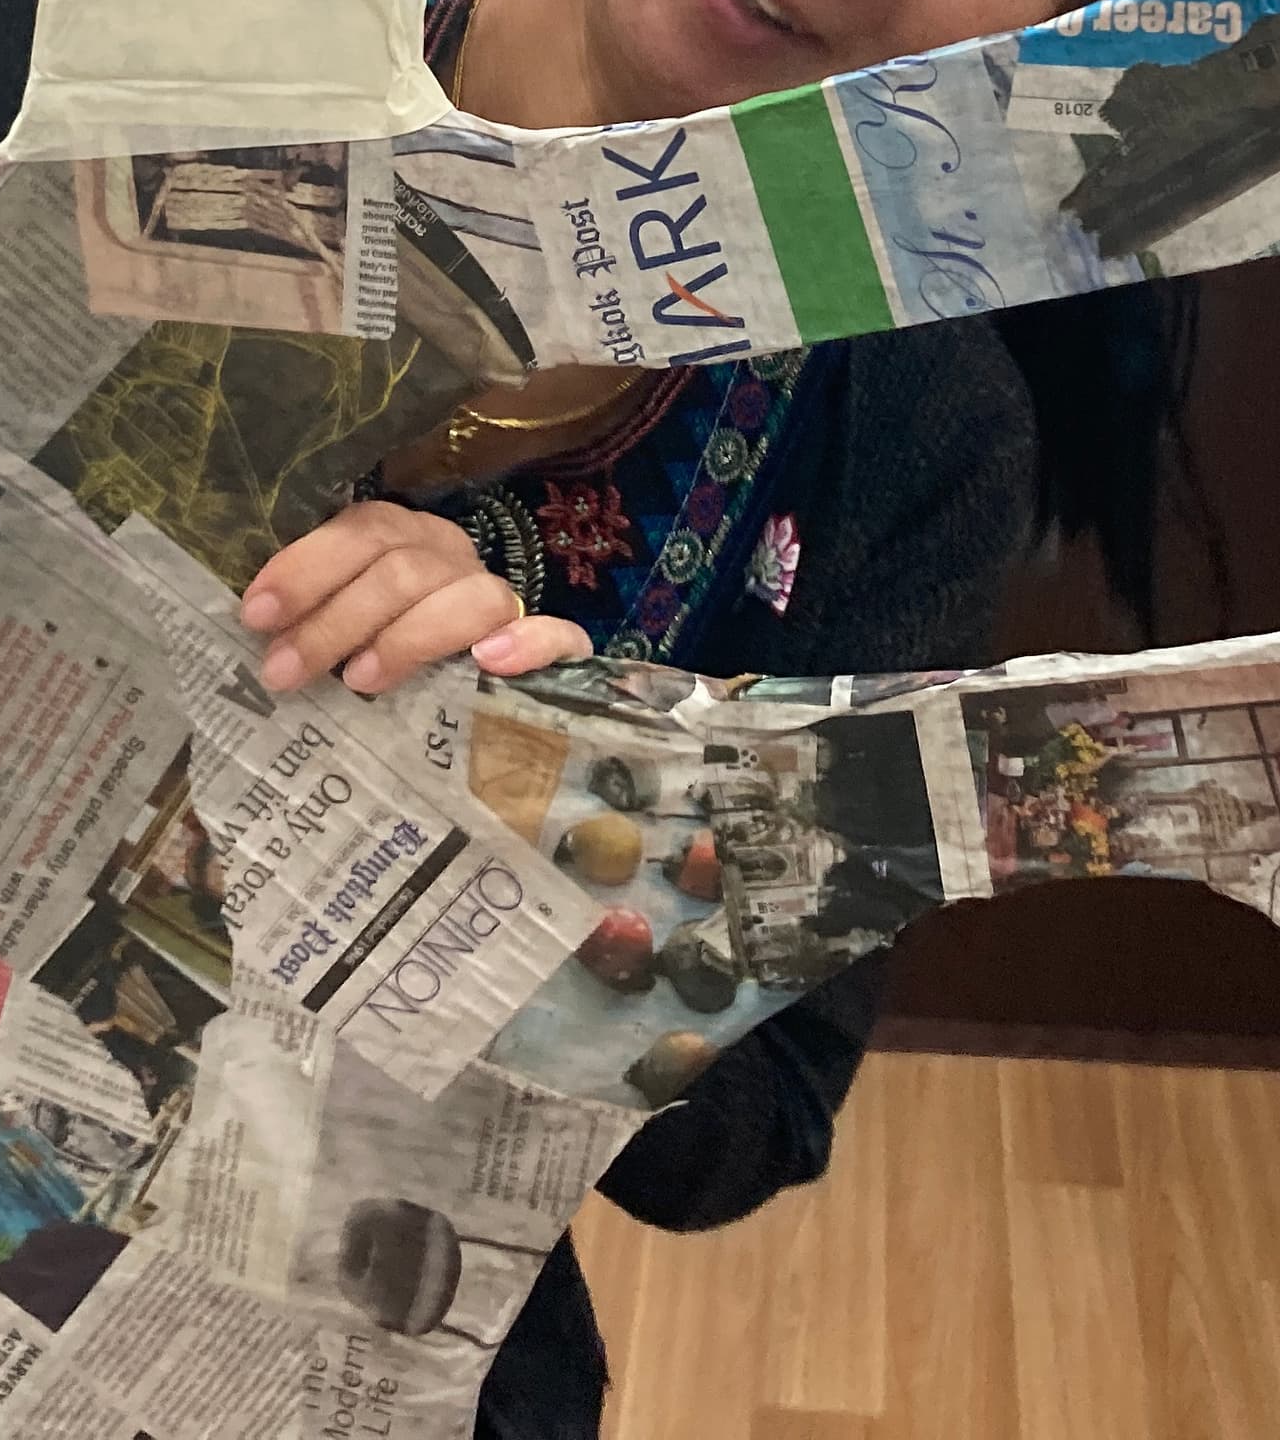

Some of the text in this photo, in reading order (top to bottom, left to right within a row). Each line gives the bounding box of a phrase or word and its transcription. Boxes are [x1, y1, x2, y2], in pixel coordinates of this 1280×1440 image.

[1054, 100, 1094, 117] 2018
[571, 196, 622, 280] Post
[268, 718, 335, 788] ban
[232, 775, 288, 830] lift
[284, 768, 355, 846] Only
[261, 832, 288, 860] a
[267, 817, 430, 989] Bangkok Post
[361, 858, 520, 1035] OPINION
